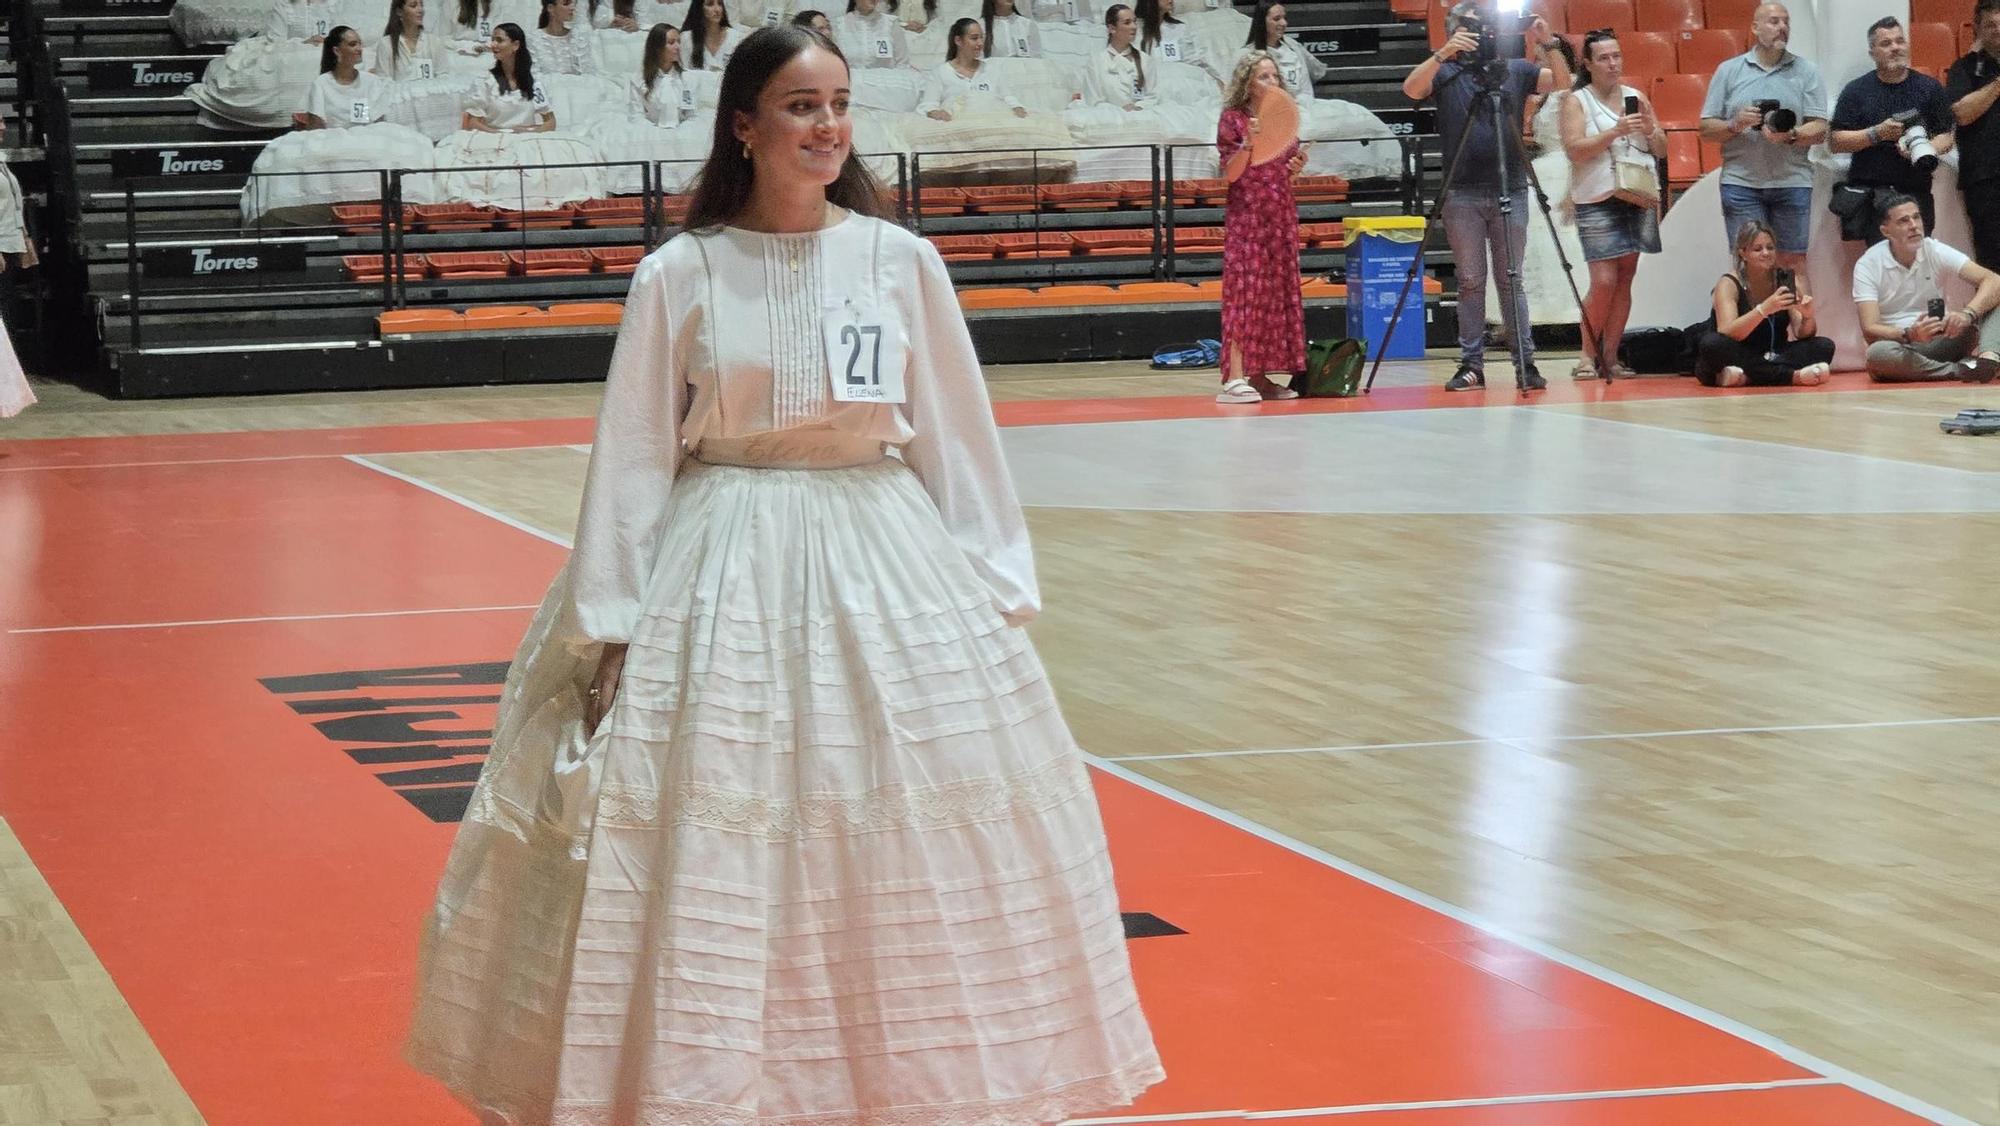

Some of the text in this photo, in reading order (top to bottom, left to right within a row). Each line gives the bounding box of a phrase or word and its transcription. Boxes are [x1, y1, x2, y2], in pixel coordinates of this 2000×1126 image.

[316, 20, 327, 35] 12
[132, 63, 195, 85] Torres
[420, 63, 430, 79] 19
[353, 103, 365, 118] 57
[159, 151, 224, 173] Torres
[191, 248, 259, 272] Torres
[840, 324, 882, 385] 27
[847, 387, 885, 398] ELENA
